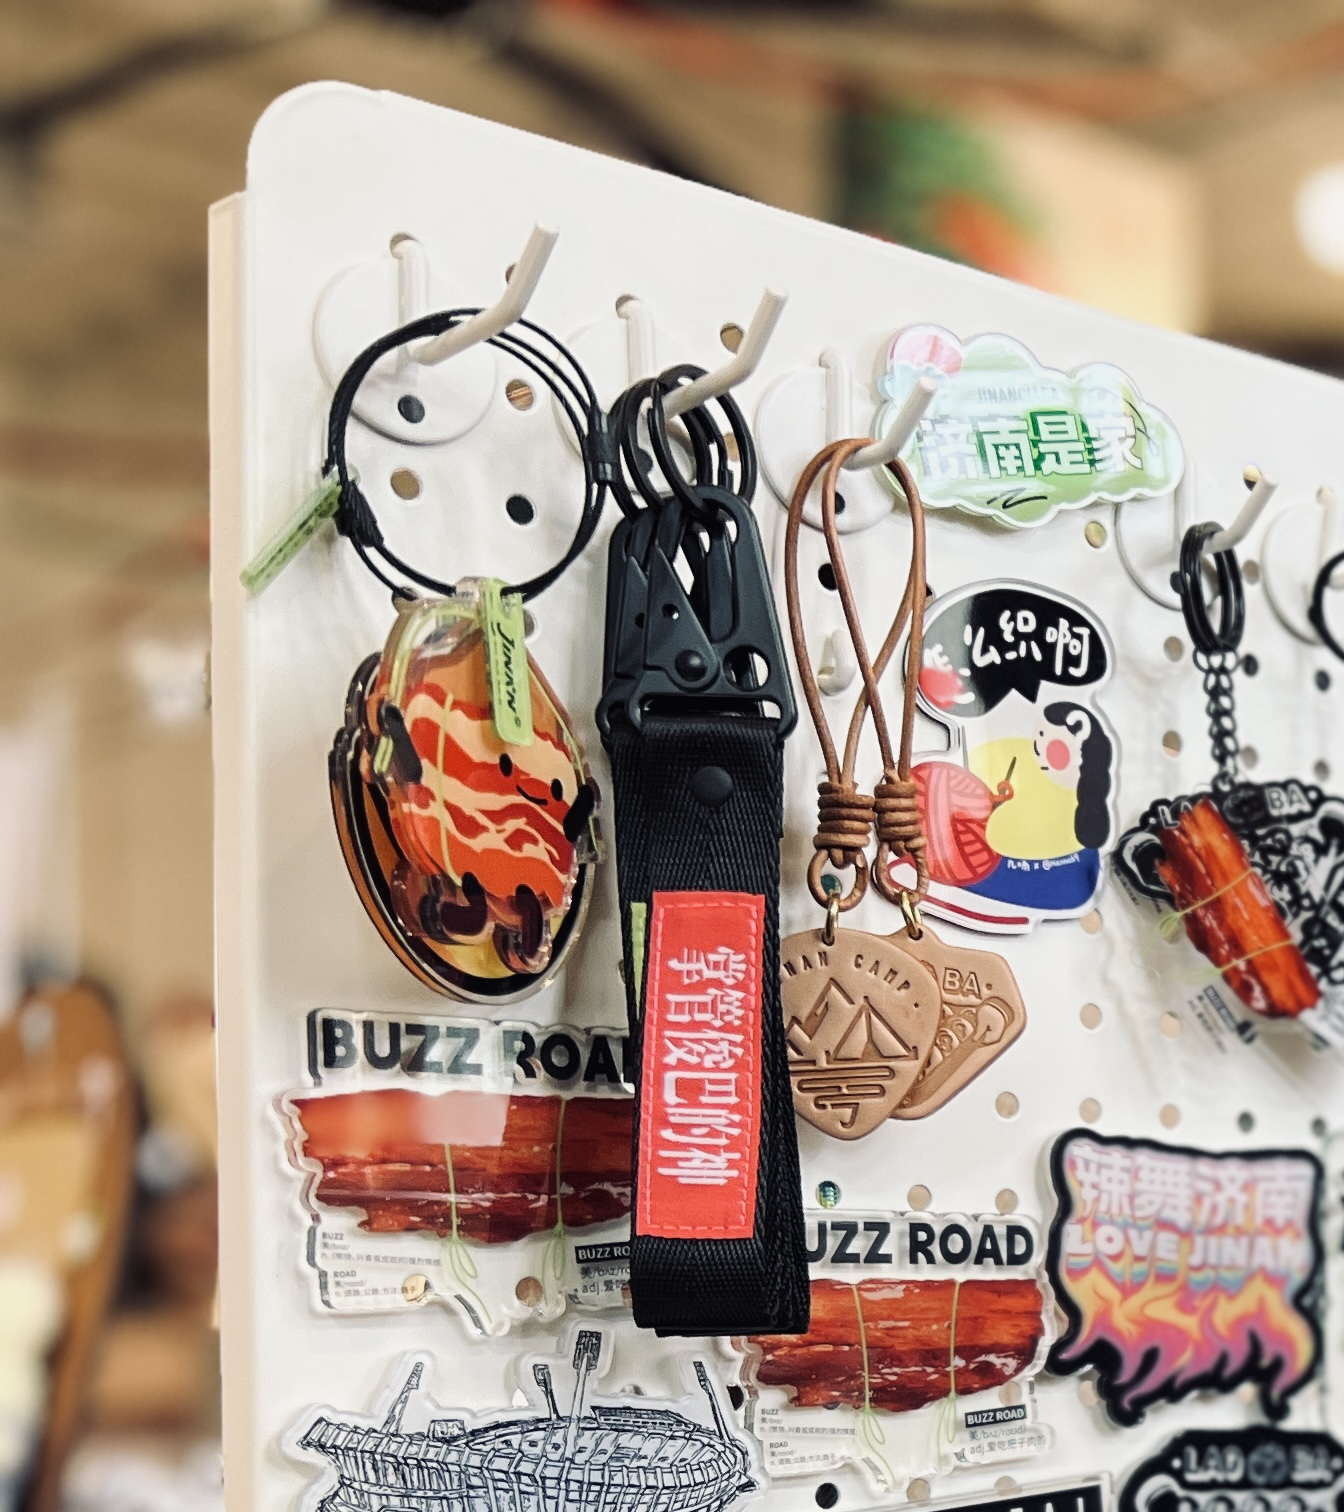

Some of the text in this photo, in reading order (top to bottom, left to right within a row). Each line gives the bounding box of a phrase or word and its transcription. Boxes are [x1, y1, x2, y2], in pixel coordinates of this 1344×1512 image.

[919, 409, 1144, 480] 济南是家
[782, 951, 912, 993] NAN CAMP
[322, 1018, 632, 1084] BUZZ ROA
[578, 1245, 631, 1260] BUZZ RO
[806, 1221, 1035, 1266] UZZ ROAD
[1063, 1223, 1181, 1261] LOVE
[966, 1407, 1026, 1425] BUZZ ROAD
